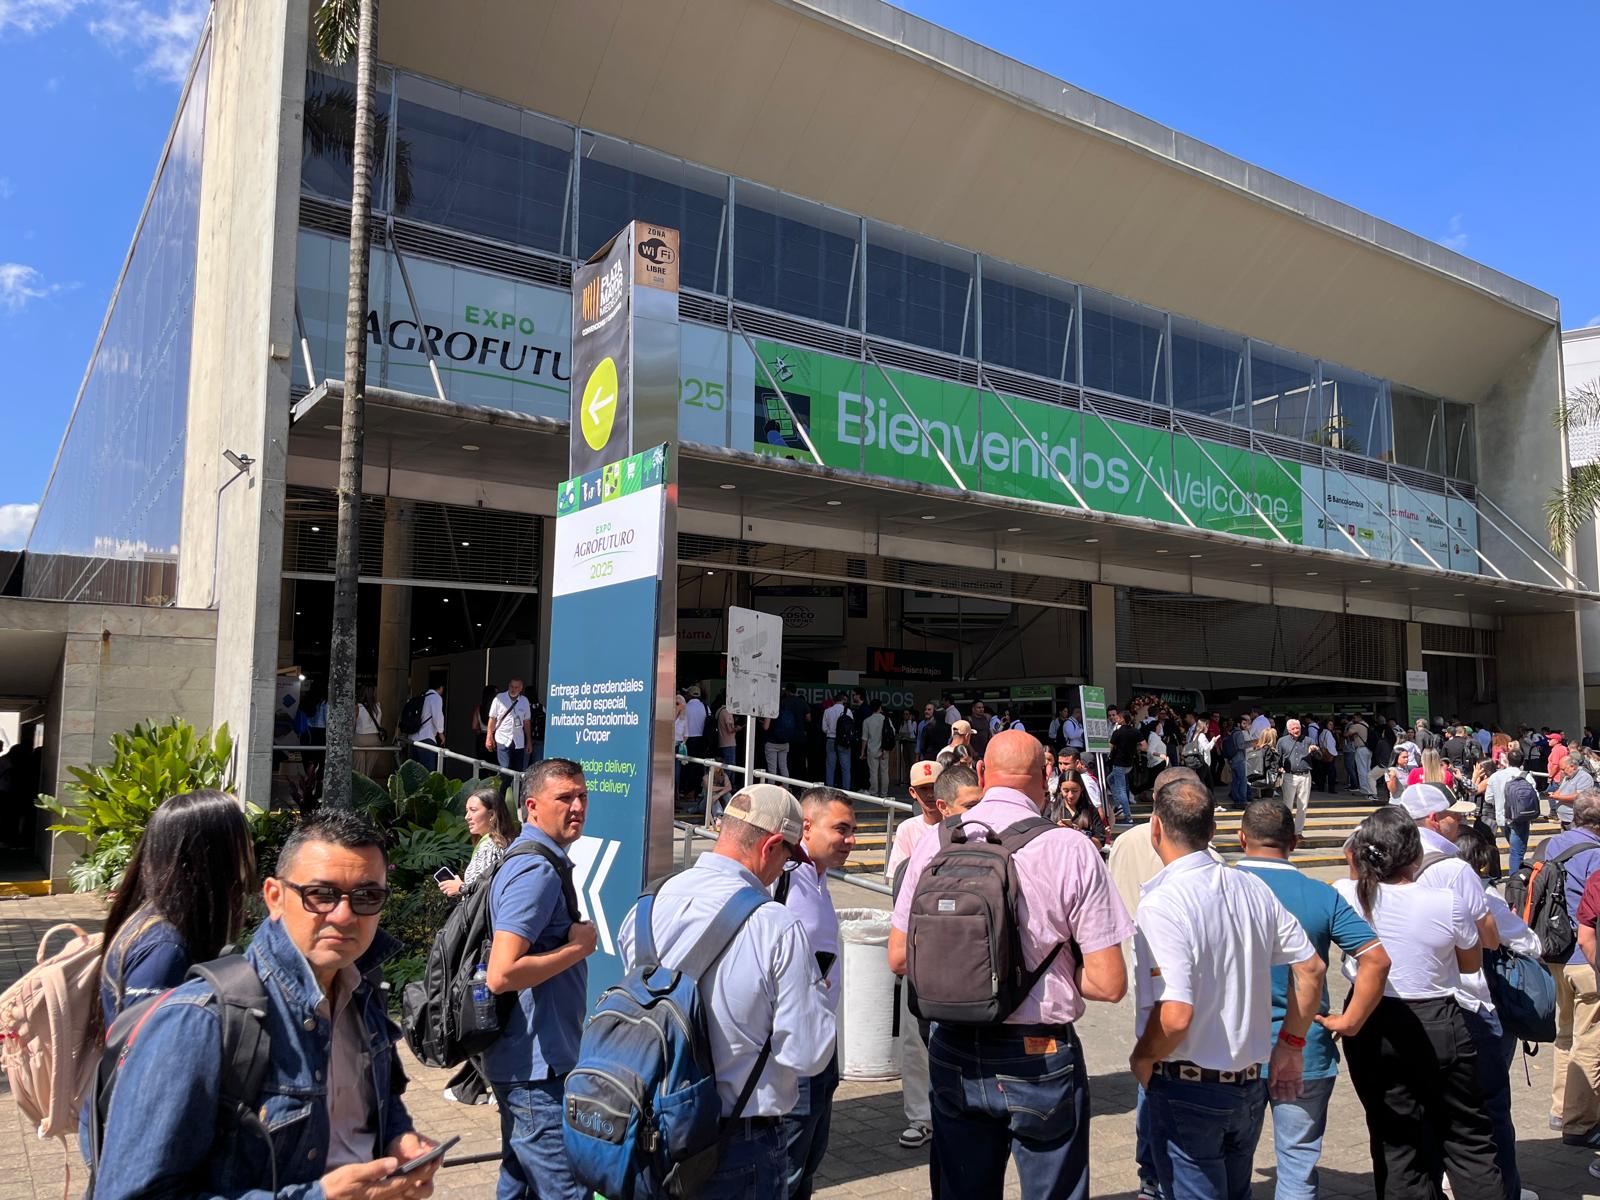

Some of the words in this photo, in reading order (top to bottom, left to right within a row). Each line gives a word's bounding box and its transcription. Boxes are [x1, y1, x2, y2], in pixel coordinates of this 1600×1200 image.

[648, 228, 666, 238] ZONA
[601, 259, 622, 288] PLAZA
[646, 265, 667, 275] LIBRE
[600, 273, 622, 306] MAYOR
[465, 304, 535, 336] EXPO
[366, 310, 571, 381] AGROFUTU
[678, 377, 724, 411] 25
[837, 390, 1130, 494] Bienvenidos
[1159, 467, 1289, 524] Welcome
[1332, 495, 1364, 509] Bancolombia
[595, 522, 612, 535] EXPO
[573, 529, 635, 559] AGROFUTURO
[590, 560, 614, 580] 2025
[677, 629, 712, 640] fama
[551, 683, 579, 698] Entrega
[581, 682, 591, 695] de
[592, 678, 644, 694] credenciales
[796, 687, 914, 708] BIENNIDOS
[561, 697, 591, 711] Invitado
[593, 695, 628, 713] especial,
[551, 713, 584, 726] invitados
[586, 711, 639, 726] Bancolombia
[575, 730, 582, 745] y
[582, 728, 611, 744] Croper
[580, 757, 603, 775] badge
[604, 759, 637, 777] delivery,
[585, 778, 599, 791] est
[599, 779, 631, 798] delivery
